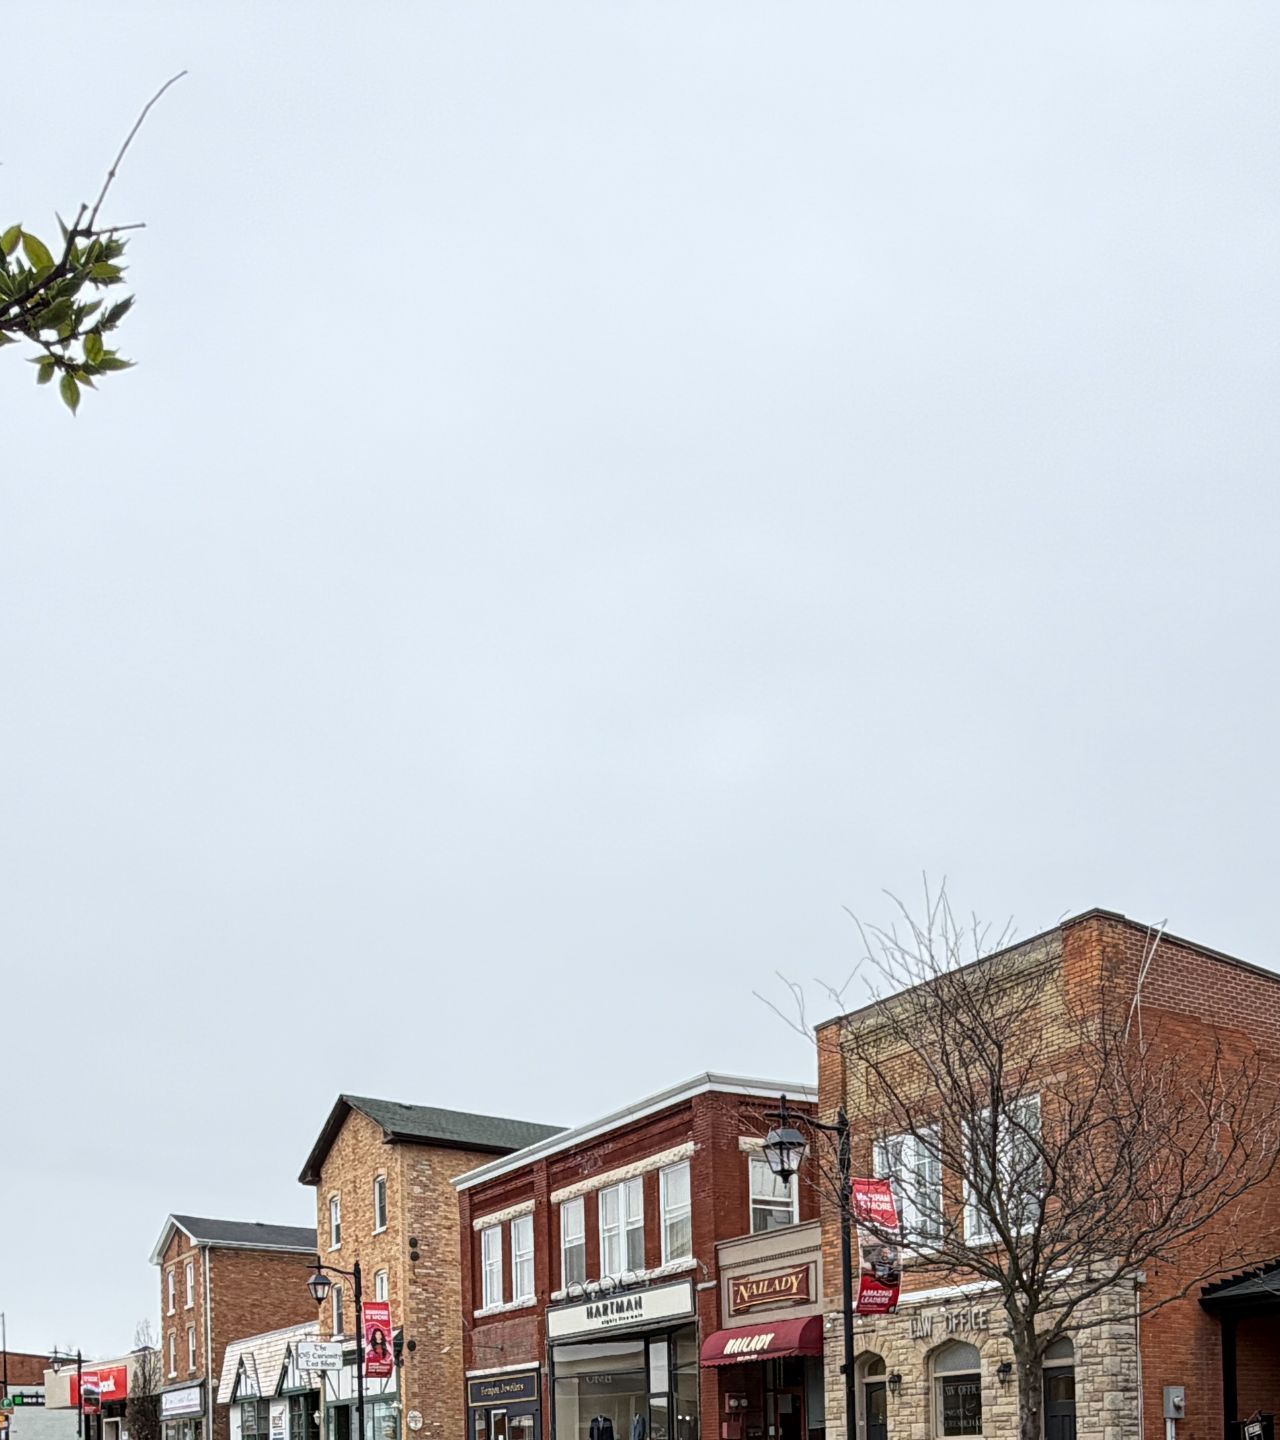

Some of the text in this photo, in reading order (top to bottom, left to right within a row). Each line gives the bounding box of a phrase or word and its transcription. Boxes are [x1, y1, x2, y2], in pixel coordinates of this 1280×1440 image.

[736, 1273, 803, 1303] NAILADY
[586, 1295, 643, 1320] HARTMAN
[910, 1308, 988, 1339] LAW OFFICE
[723, 1333, 775, 1355] NAILADY
